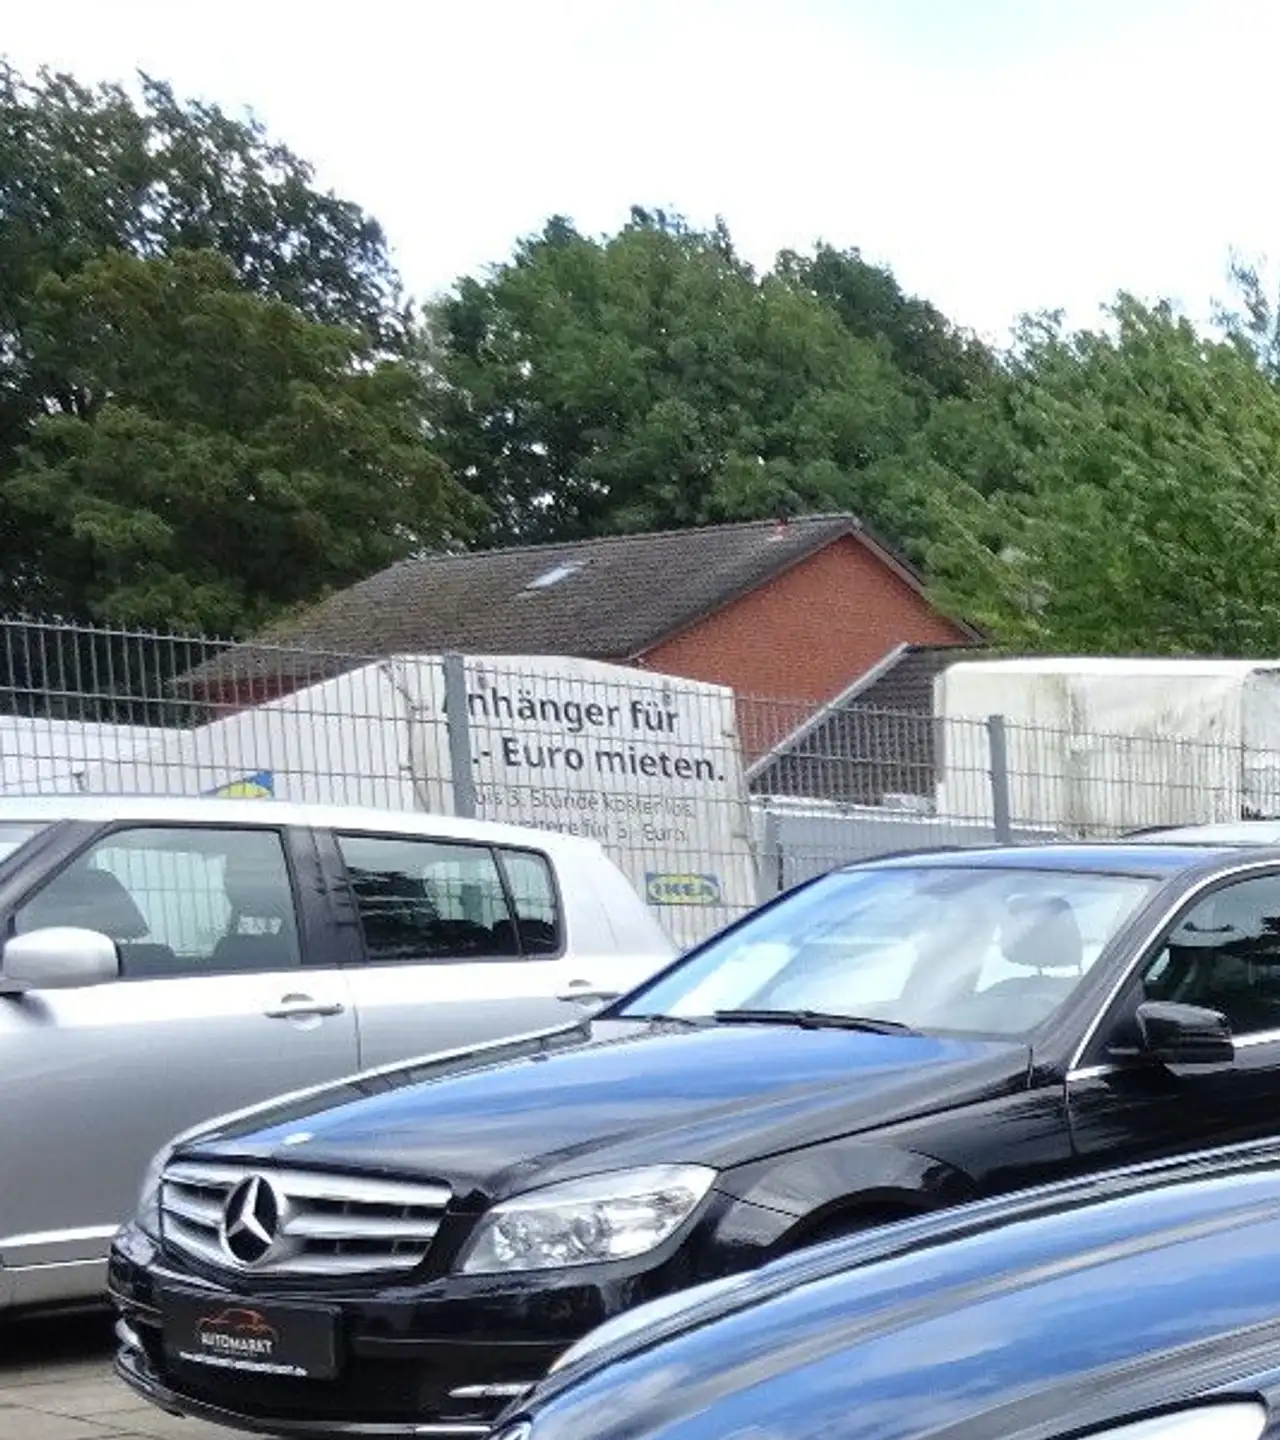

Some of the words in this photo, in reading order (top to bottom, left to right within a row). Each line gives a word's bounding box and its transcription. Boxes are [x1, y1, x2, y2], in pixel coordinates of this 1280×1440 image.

[443, 687, 619, 733] nhänger
[631, 700, 680, 733] für
[502, 736, 584, 772] Euro
[596, 746, 725, 781] mieten.
[201, 1331, 273, 1354] AUTOMARKT
